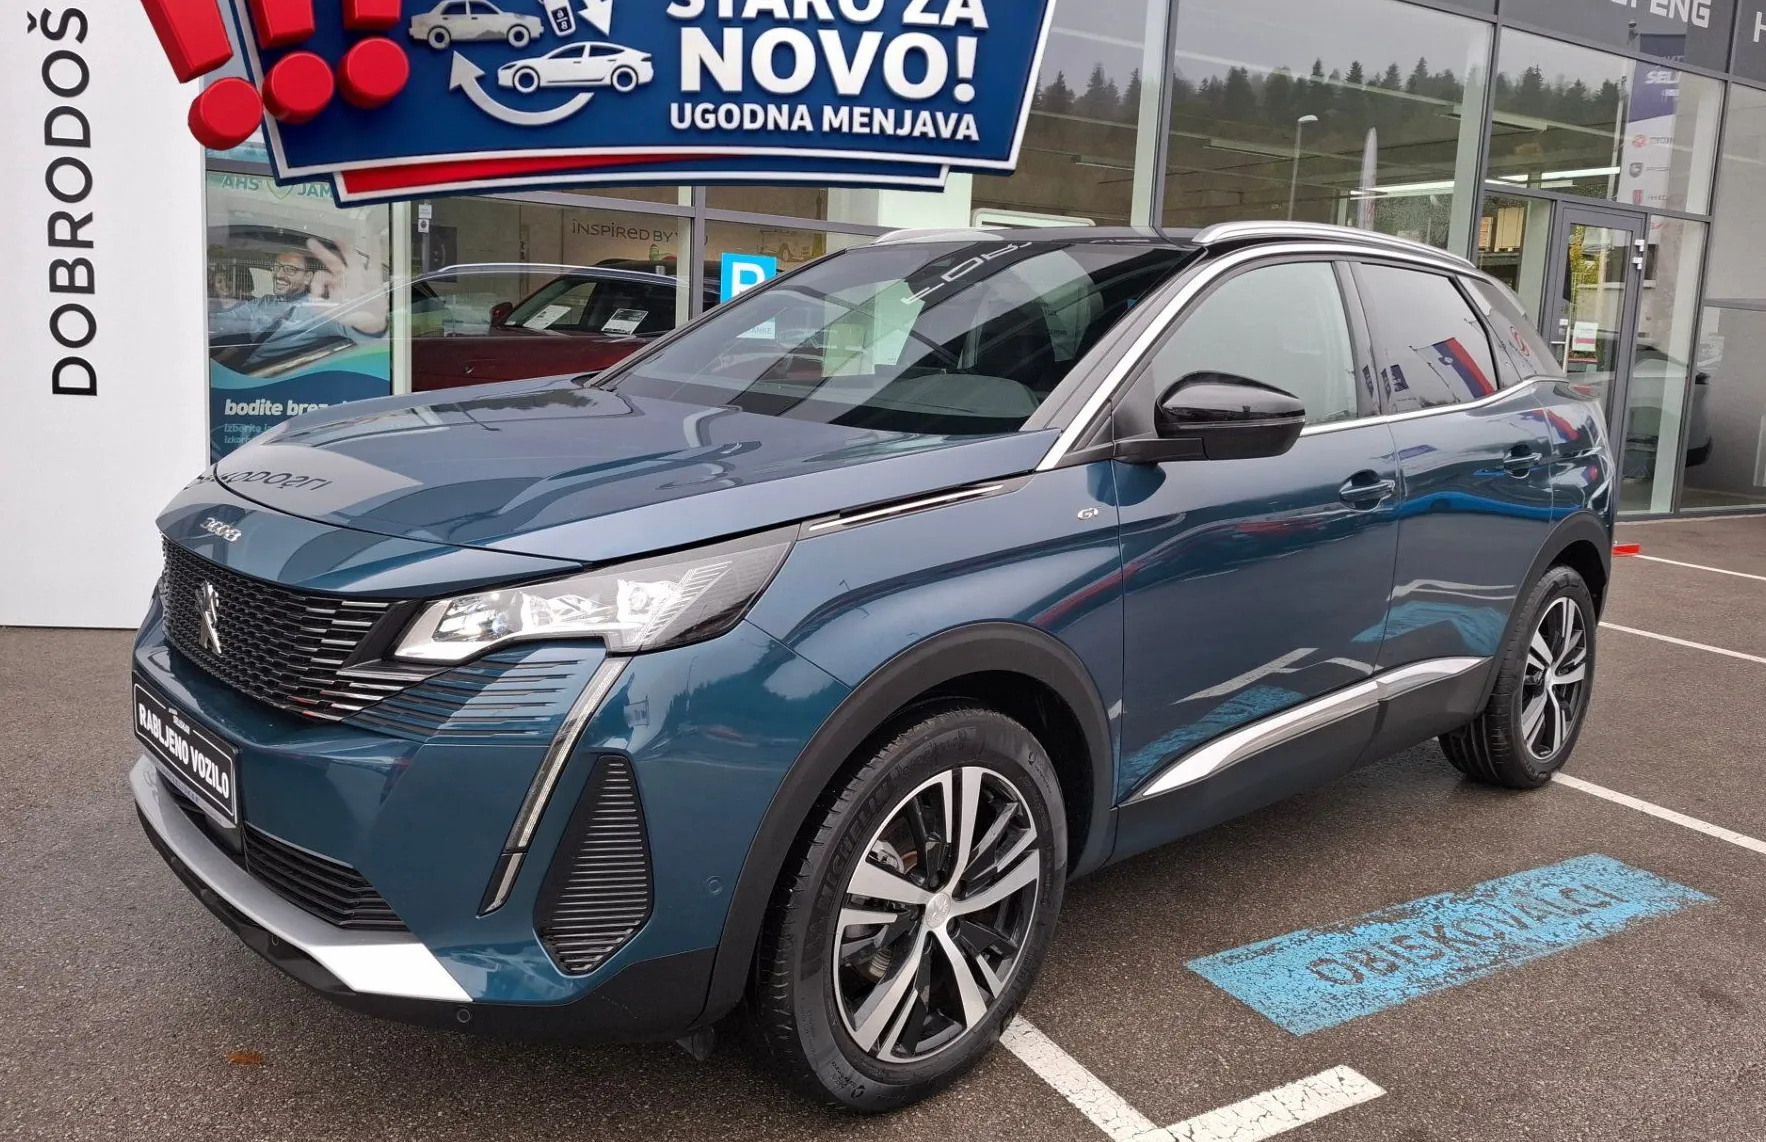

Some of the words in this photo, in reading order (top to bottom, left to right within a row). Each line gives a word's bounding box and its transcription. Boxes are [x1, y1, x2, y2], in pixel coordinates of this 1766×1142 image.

[1610, 0, 1712, 28] ENG
[27, 8, 97, 396] DOBRODOŠ
[298, 182, 333, 198] JAM
[731, 261, 766, 298] P
[224, 399, 284, 416] bodite
[200, 517, 242, 542] 3008
[138, 703, 189, 765] RABLJENO
[190, 746, 229, 799] VOZILO
